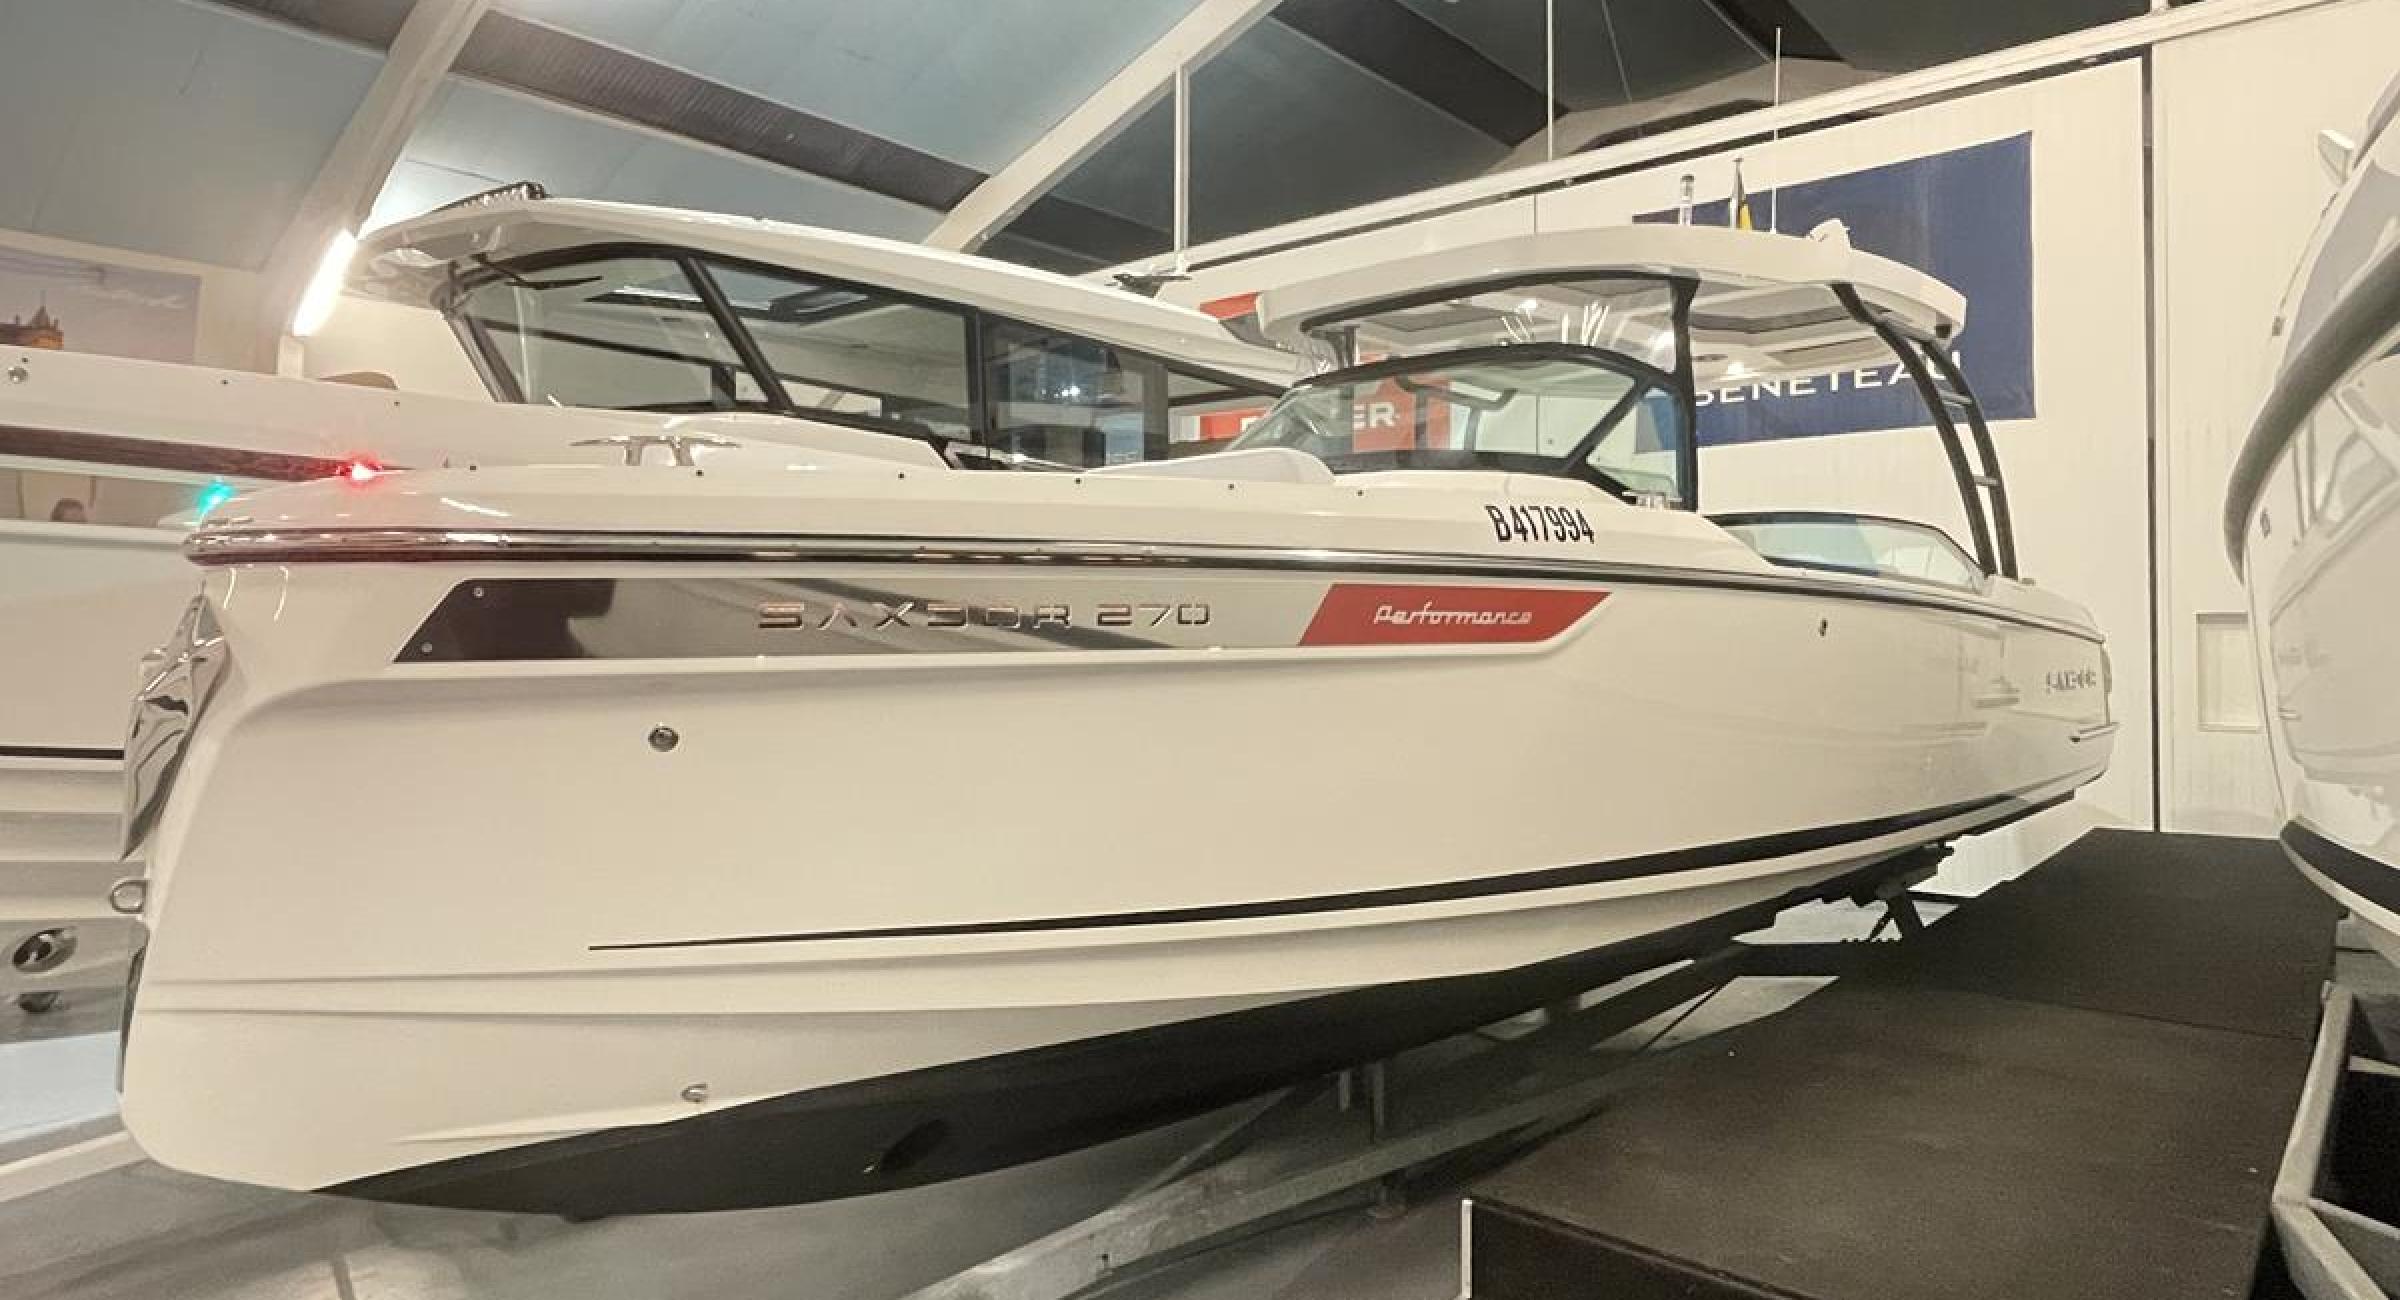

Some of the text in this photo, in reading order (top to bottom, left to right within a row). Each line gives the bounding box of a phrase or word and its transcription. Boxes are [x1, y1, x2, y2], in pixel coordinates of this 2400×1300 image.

[1484, 505, 1595, 544] B417994
[758, 602, 1211, 630] SAXDOR 270
[1373, 600, 1533, 625] Performance
